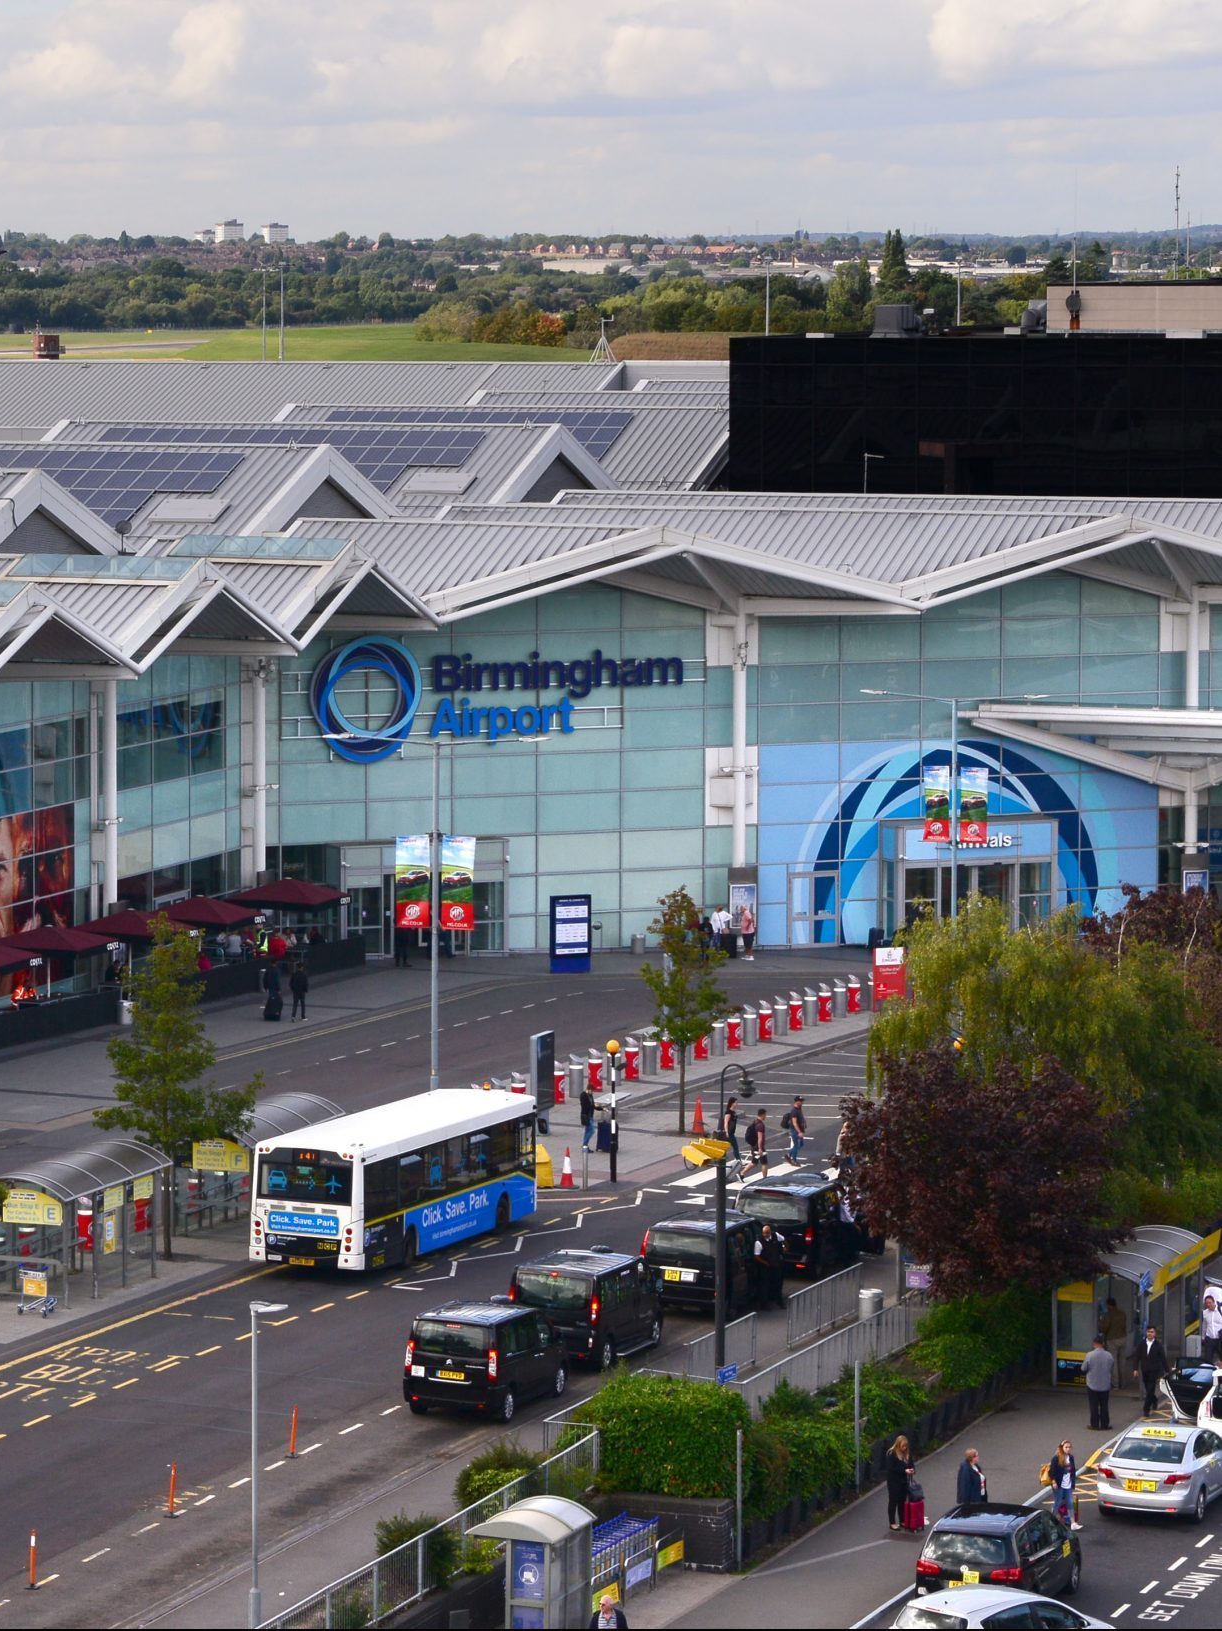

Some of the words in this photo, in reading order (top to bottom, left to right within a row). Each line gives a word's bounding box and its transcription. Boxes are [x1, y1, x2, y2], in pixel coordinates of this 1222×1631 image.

[433, 649, 683, 698] Birmingham
[431, 696, 575, 745] Airport
[235, 1154, 243, 1166] F
[47, 1207, 57, 1220] E
[270, 1215, 291, 1224] Click.
[293, 1217, 315, 1226] Save.
[316, 1219, 337, 1227] Park.
[422, 1206, 444, 1228] Click.
[445, 1200, 468, 1220] Save.
[469, 1189, 490, 1212] Park.
[1164, 1571, 1221, 1599] DOWN
[1137, 1600, 1185, 1622] SET
